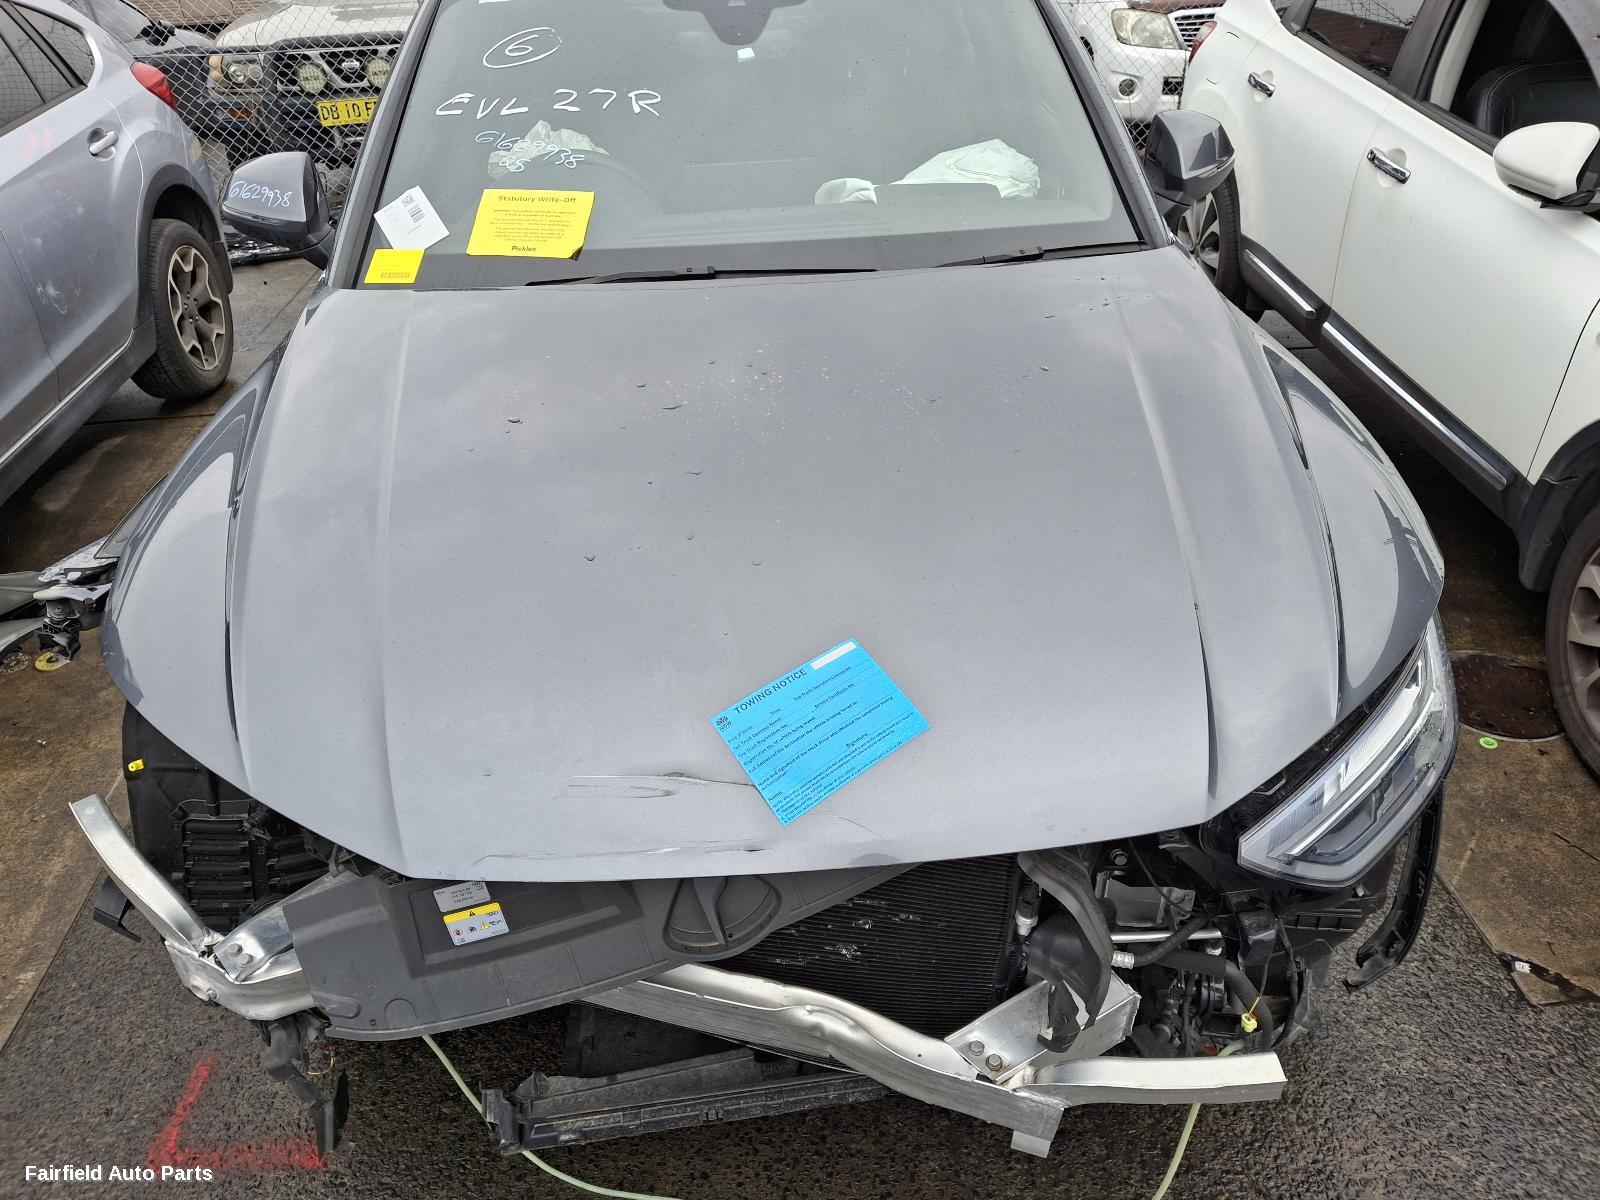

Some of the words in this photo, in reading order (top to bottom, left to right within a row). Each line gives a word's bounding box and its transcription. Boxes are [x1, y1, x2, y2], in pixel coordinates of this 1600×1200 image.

[505, 34, 539, 56] 6
[435, 93, 529, 120] EVL
[228, 180, 293, 208] 61629938
[498, 195, 536, 204] Statutory
[538, 196, 577, 204] Write-Off
[511, 245, 537, 253] Pickles
[732, 687, 773, 715] TOWING
[770, 667, 808, 692] NOTICE
